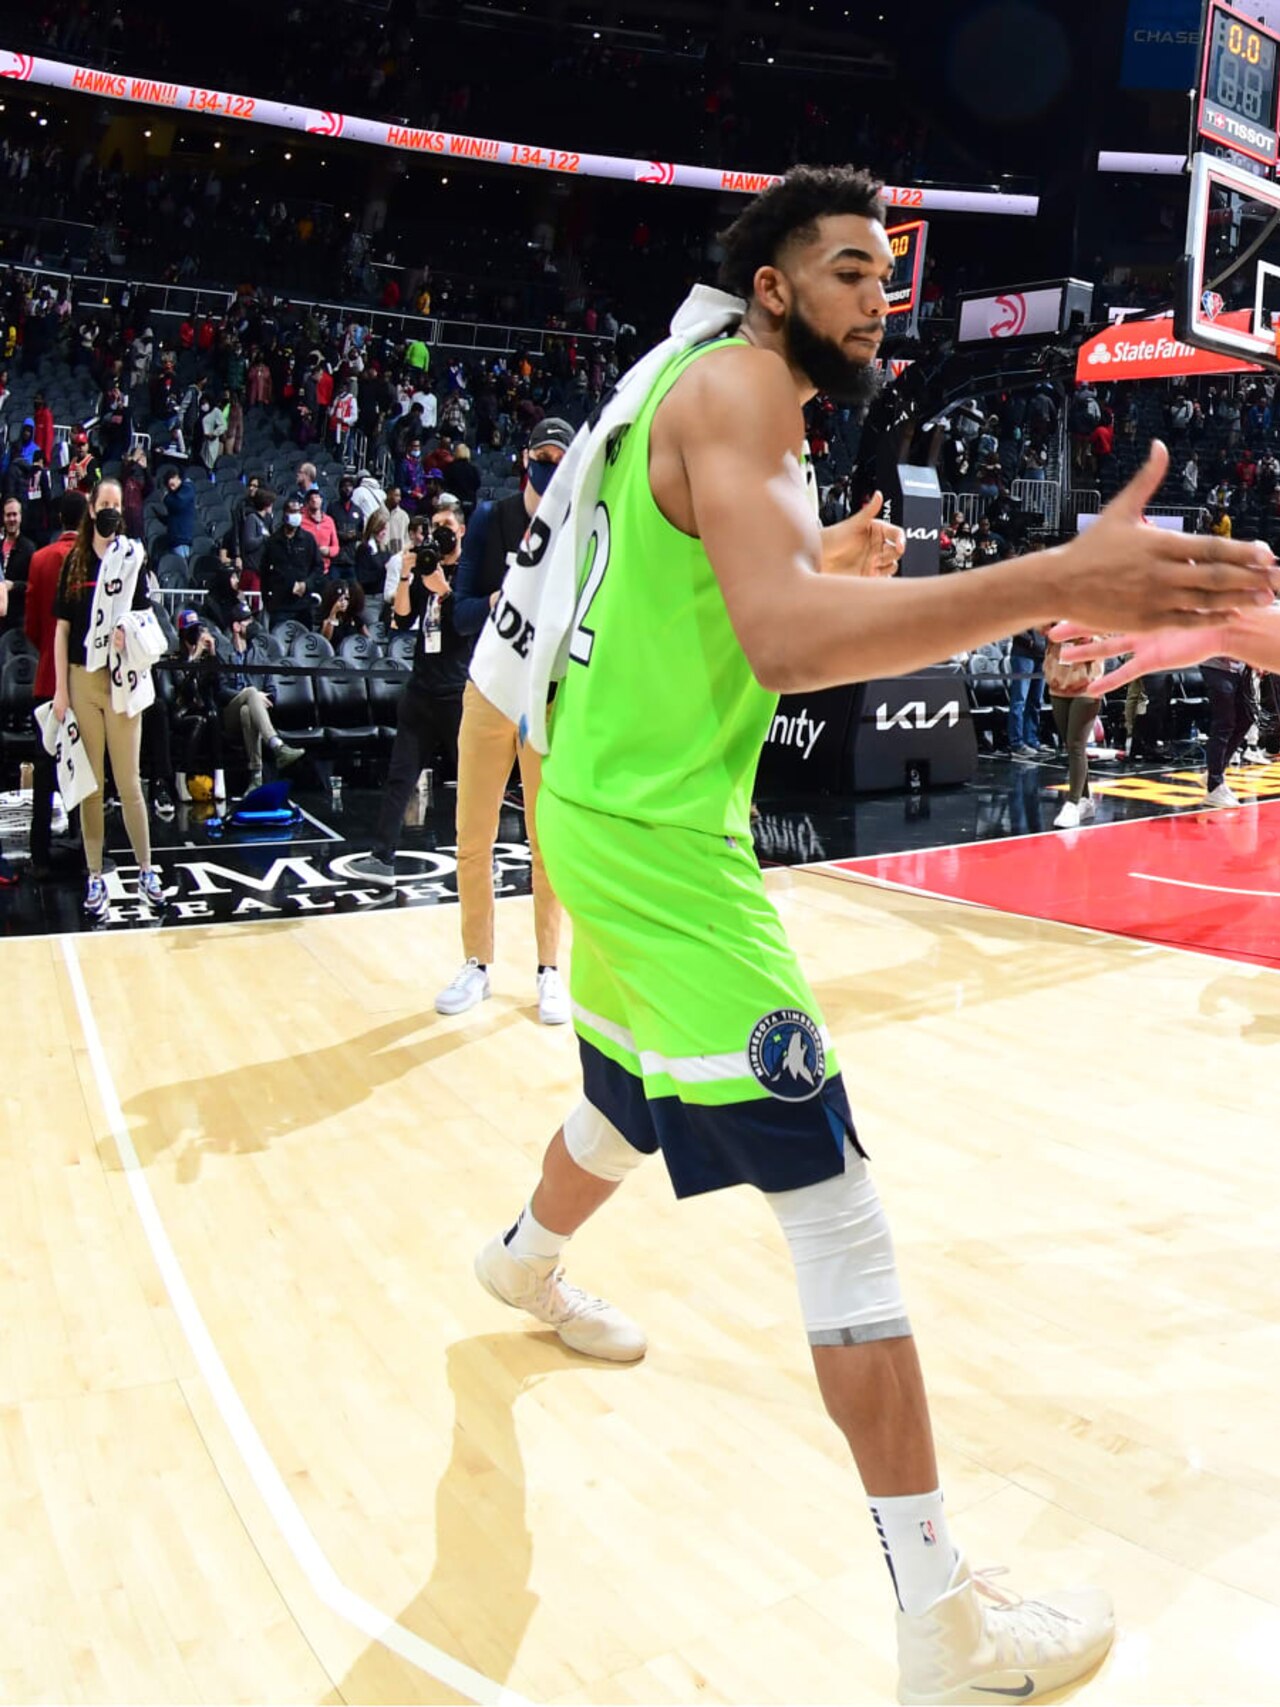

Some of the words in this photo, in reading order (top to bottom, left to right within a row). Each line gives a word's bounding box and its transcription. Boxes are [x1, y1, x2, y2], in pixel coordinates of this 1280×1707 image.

[71, 69, 126, 97] HAWKS
[130, 79, 179, 105] WIN!!!
[187, 89, 255, 119] 134-122
[386, 126, 446, 153] HAWKS
[449, 135, 500, 161] WIN!!!
[510, 145, 581, 173] 134-122
